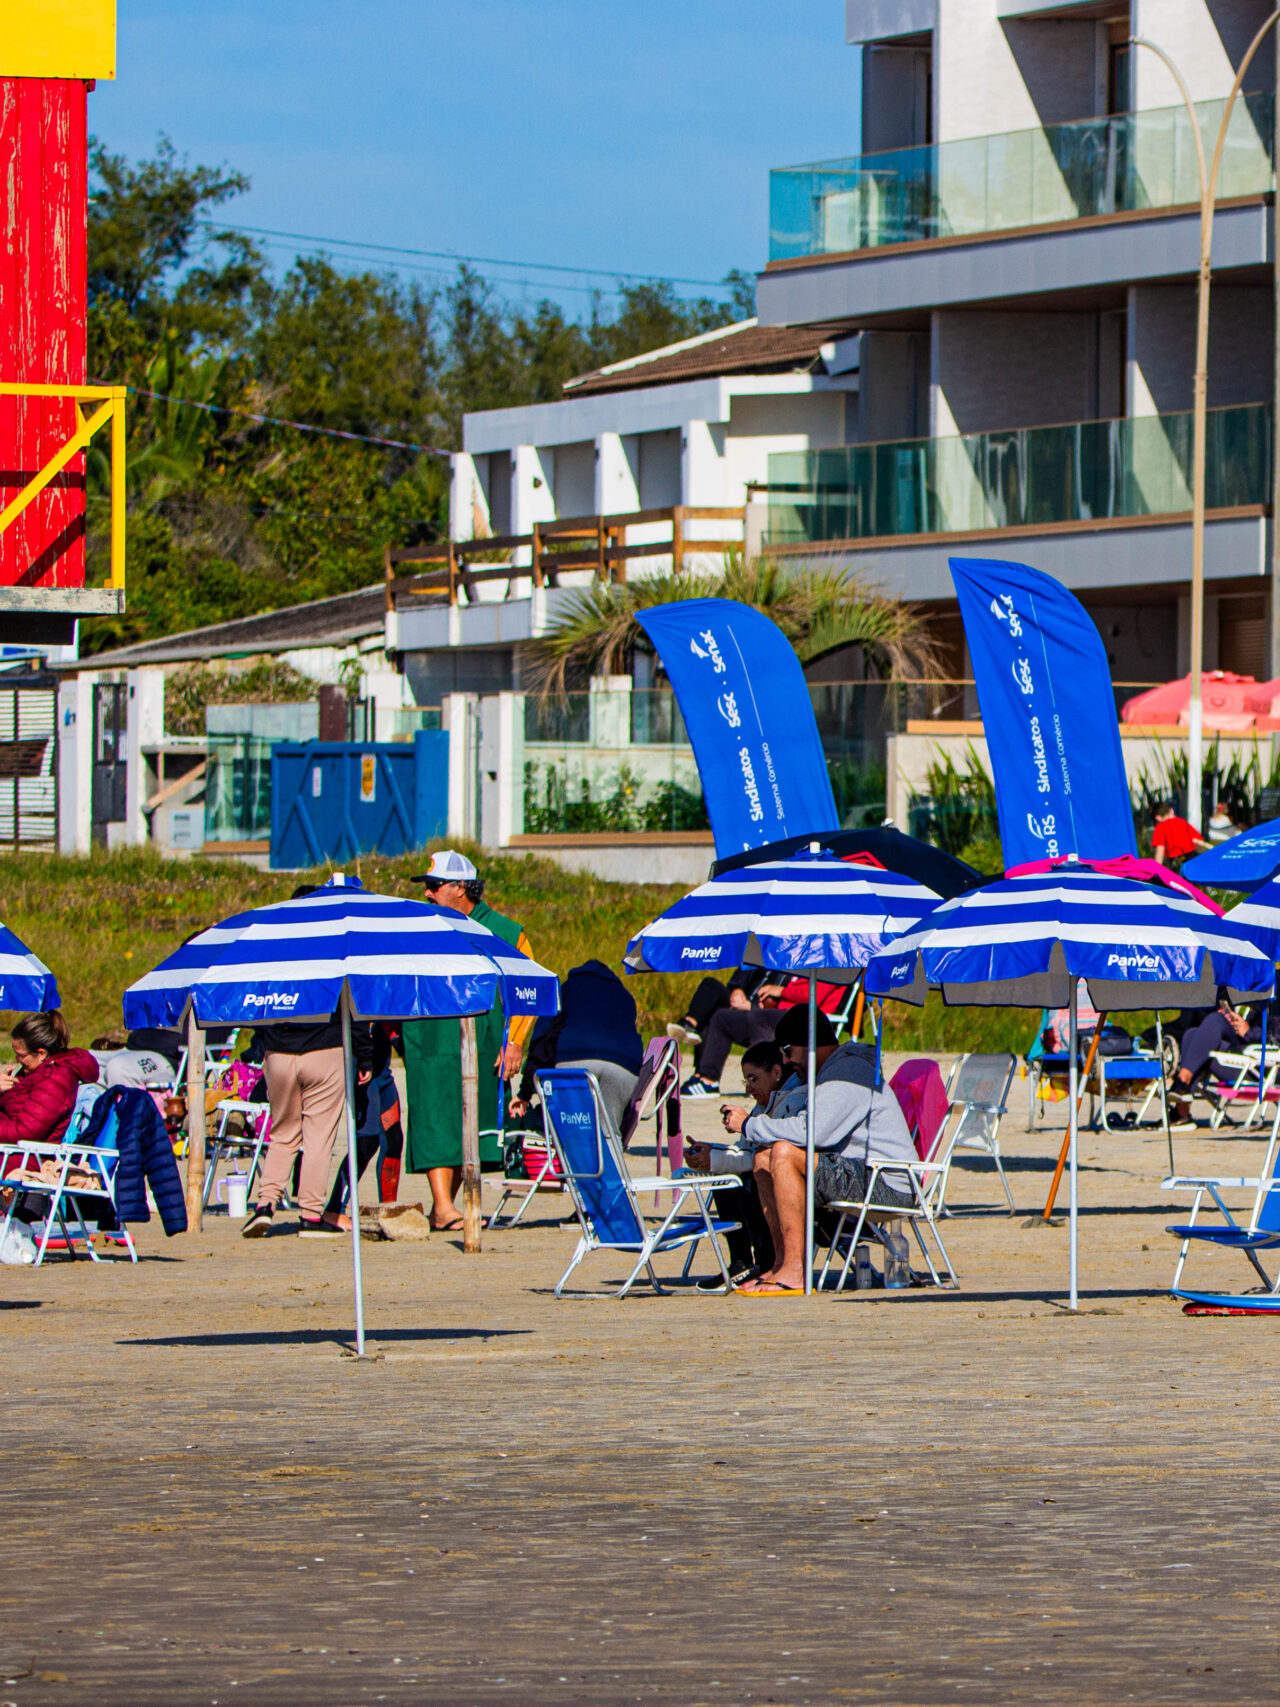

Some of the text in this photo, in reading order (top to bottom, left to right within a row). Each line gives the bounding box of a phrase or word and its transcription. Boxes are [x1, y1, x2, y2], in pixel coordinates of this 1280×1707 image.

[699, 629, 727, 674] Senac
[1018, 658, 1034, 695] Sesc
[723, 691, 742, 728] Sesc
[1030, 716, 1051, 793] Sindicatos
[1053, 714, 1073, 796] Sistema Comércio
[739, 747, 764, 822] Sindicatos
[761, 742, 785, 821] Sistema Comércio
[1042, 814, 1057, 835] RS
[680, 945, 723, 959] PanVel
[1107, 953, 1160, 968] PanVel
[242, 992, 300, 1007] PanVel
[560, 1111, 591, 1124] PanVel
